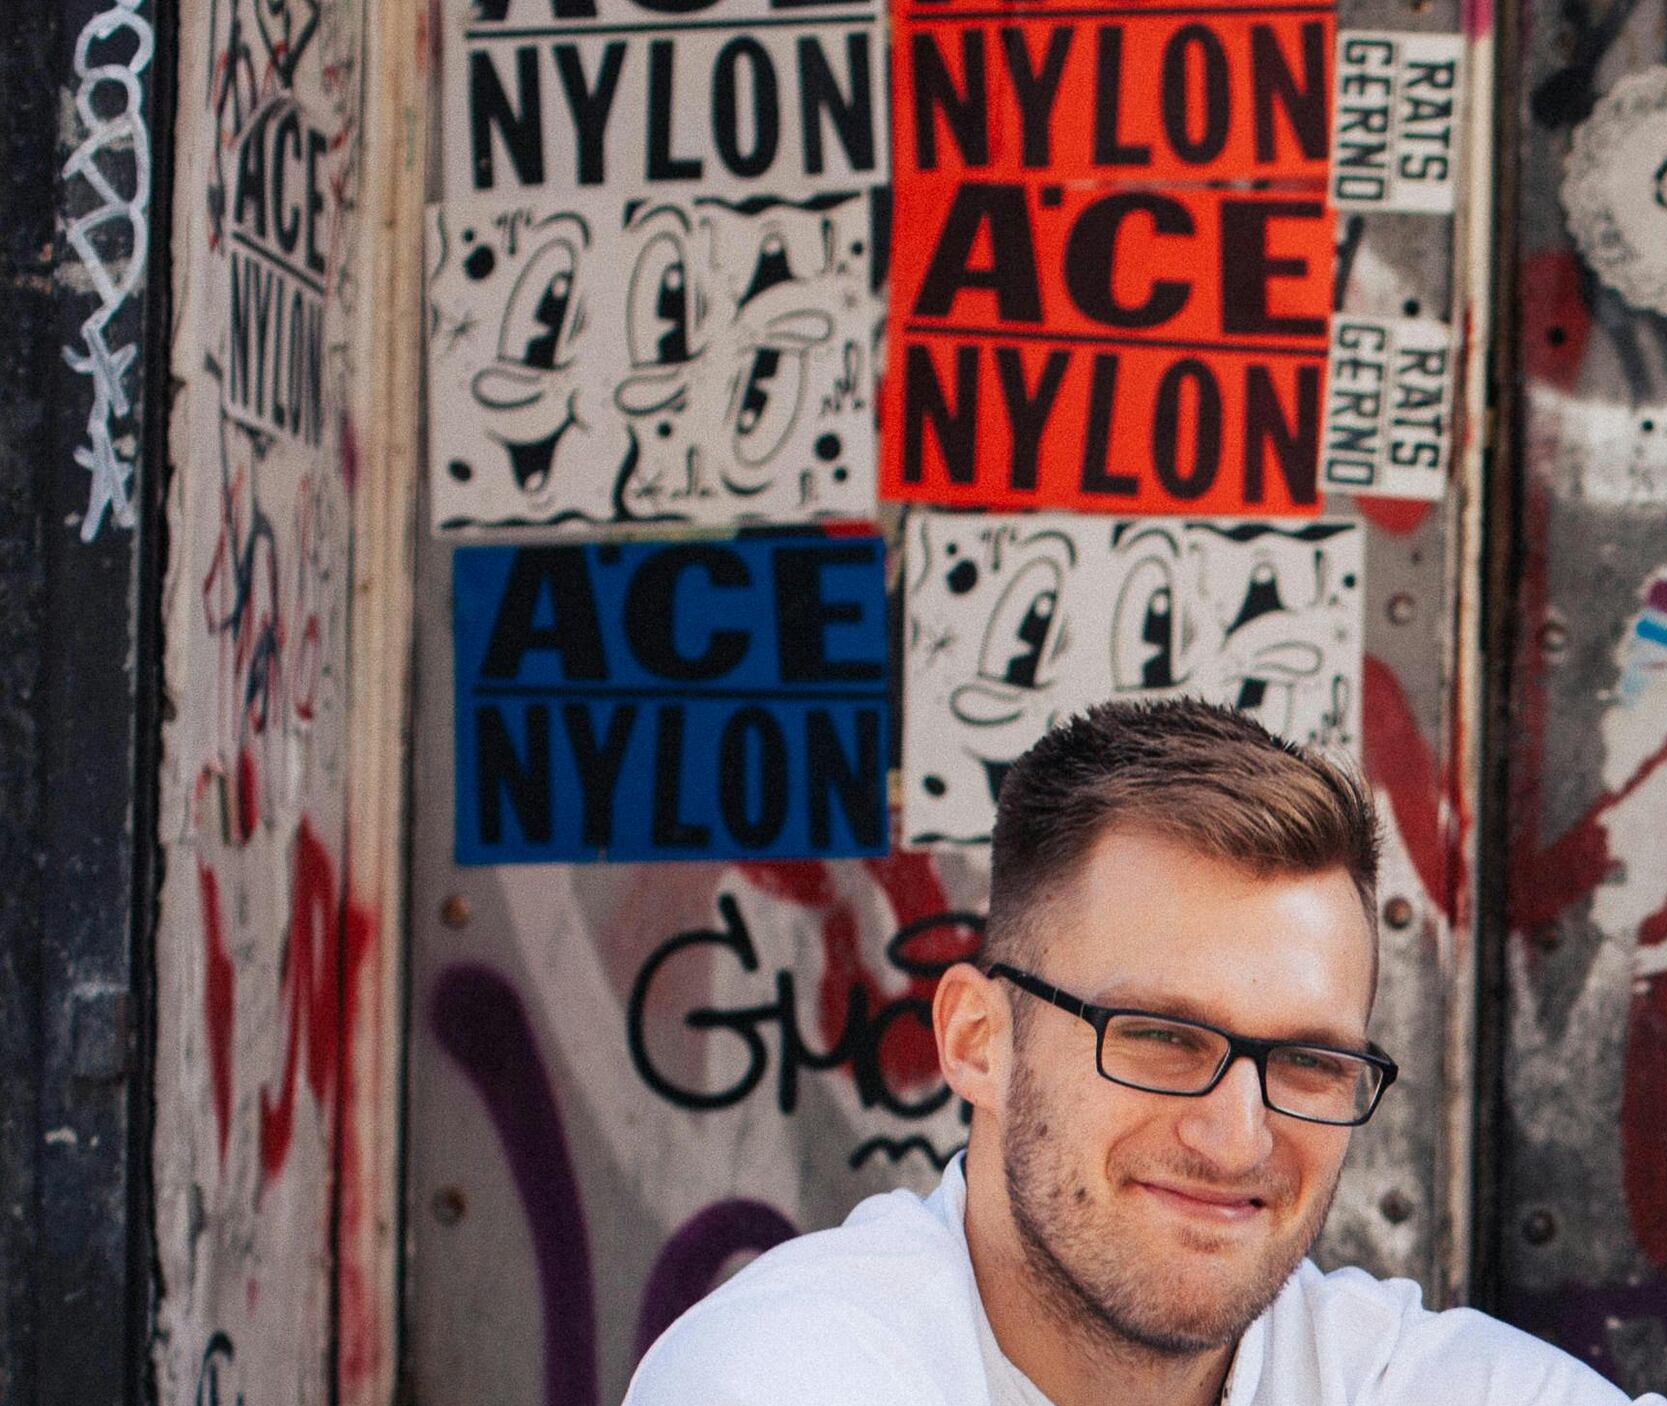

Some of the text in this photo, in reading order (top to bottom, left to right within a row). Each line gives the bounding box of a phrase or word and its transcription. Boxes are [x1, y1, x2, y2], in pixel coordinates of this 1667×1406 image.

[469, 32, 876, 190] NYLON
[910, 21, 1330, 171] NYLON
[1400, 58, 1456, 181] RATS
[234, 110, 327, 273] ACE
[911, 181, 1328, 337] ACE
[230, 252, 324, 446] NYLON
[902, 343, 1320, 506] NYLON
[1391, 348, 1446, 468] RATS
[480, 543, 884, 683] ACE
[477, 704, 884, 851] NYLON
